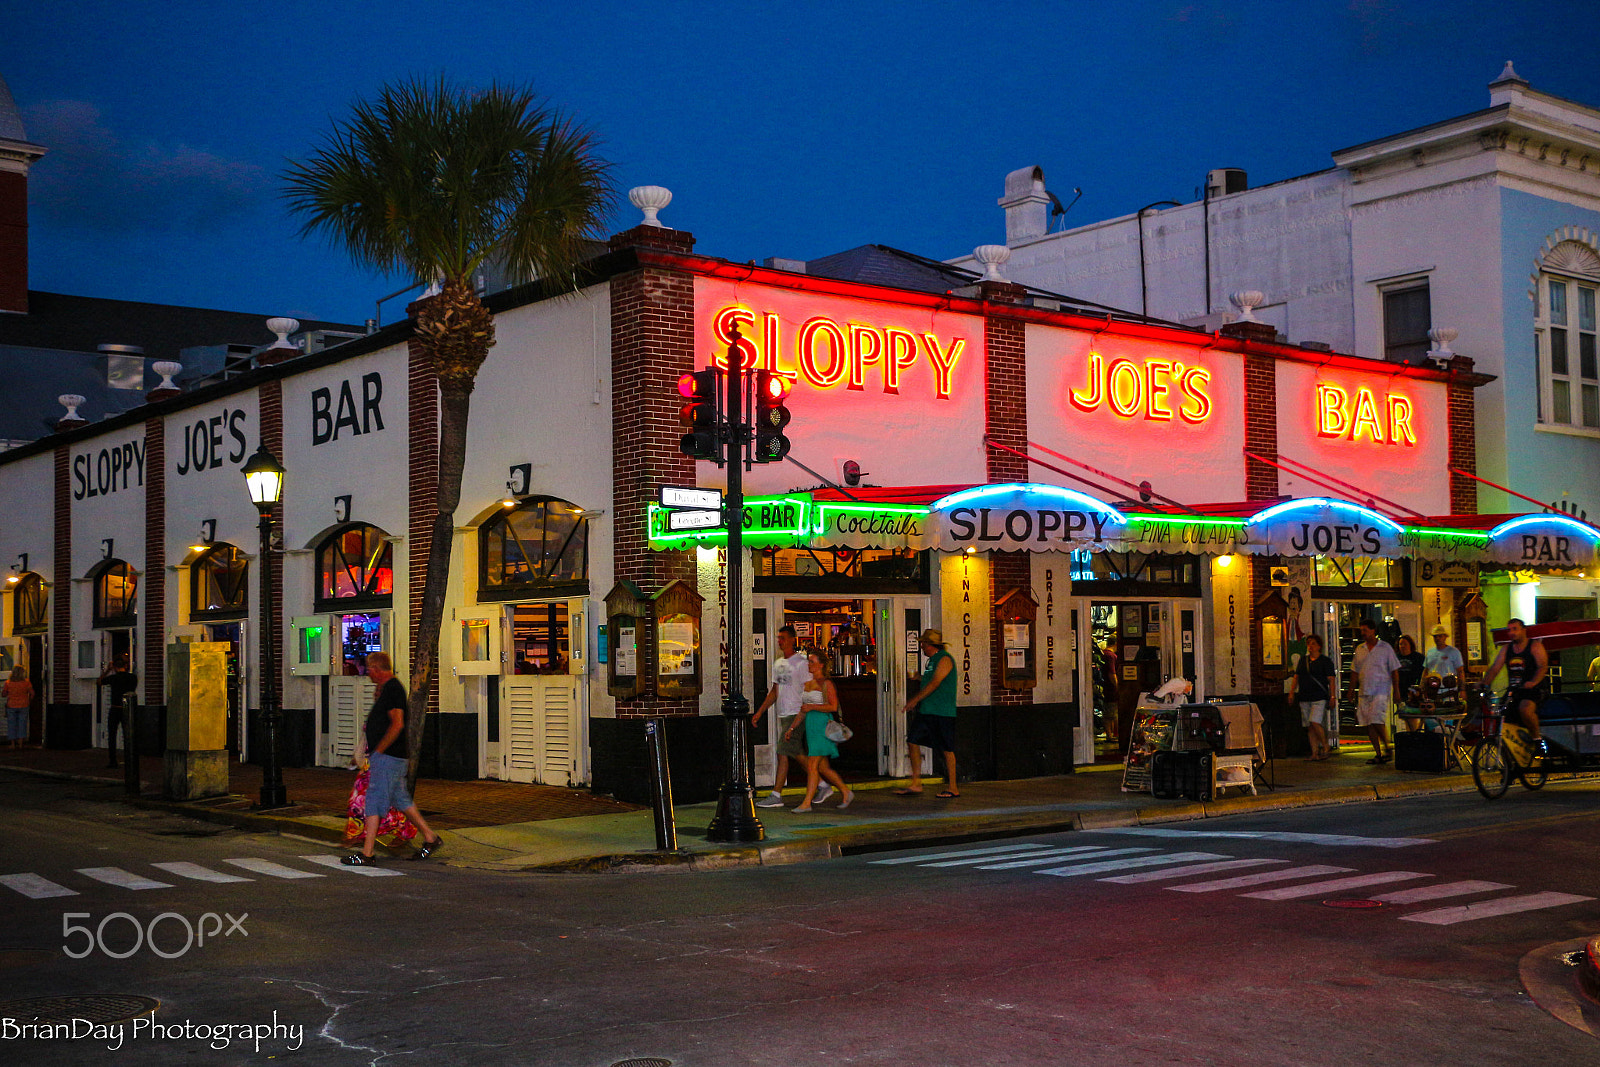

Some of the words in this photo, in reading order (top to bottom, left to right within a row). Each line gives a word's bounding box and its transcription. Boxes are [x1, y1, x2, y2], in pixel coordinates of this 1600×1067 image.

[711, 306, 965, 400] SLOPPY
[1069, 353, 1211, 425] JOE'S
[1316, 383, 1416, 447] BAR
[74, 437, 146, 500] SLOPPY
[177, 408, 247, 476] JOE'S
[312, 371, 385, 446] BAR
[761, 505, 795, 528] BAR
[836, 510, 924, 537] Cocktails
[949, 508, 1110, 542] SLOPPY
[1291, 523, 1381, 554] JOE'S
[1521, 535, 1572, 562] BAR
[718, 546, 730, 699] NTERTAINMEN
[1228, 594, 1237, 689] COCKTAILS
[963, 613, 971, 695] COLADAS
[1046, 636, 1054, 681] BEER
